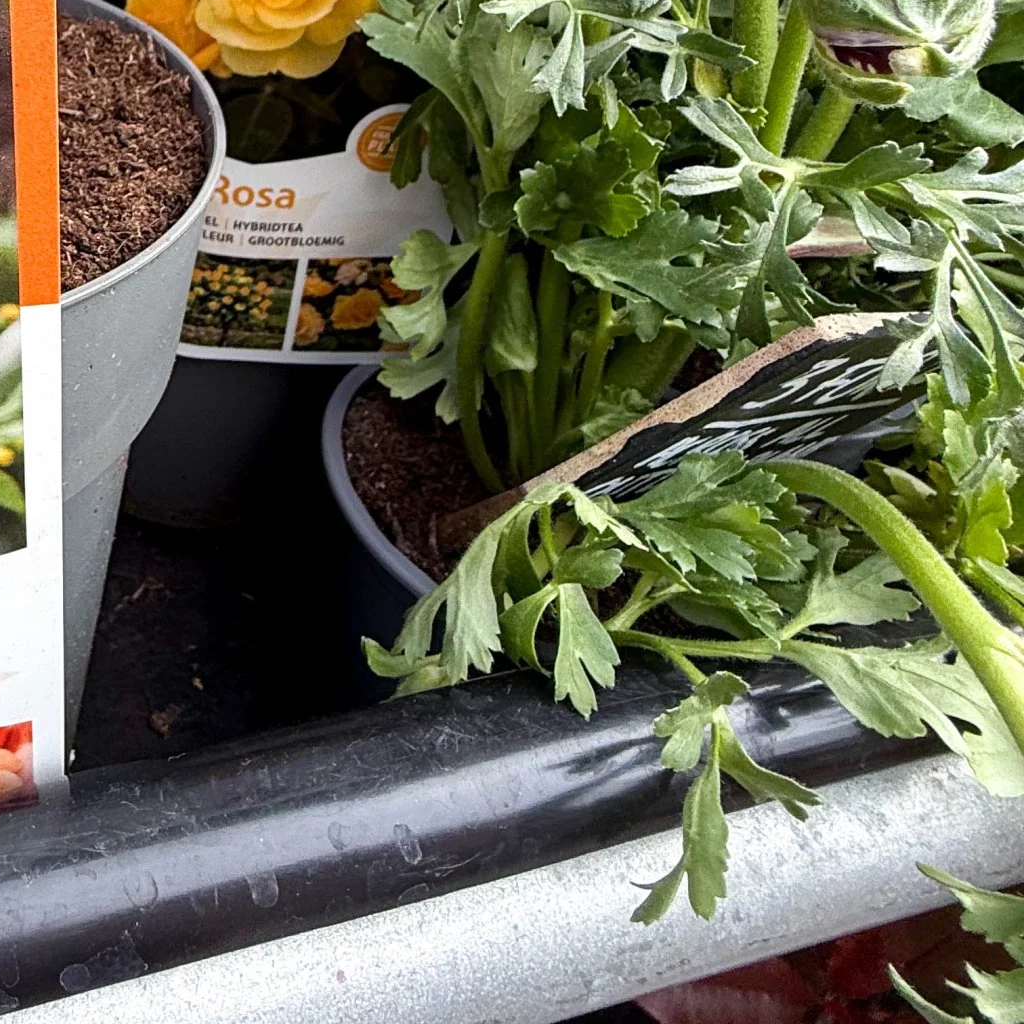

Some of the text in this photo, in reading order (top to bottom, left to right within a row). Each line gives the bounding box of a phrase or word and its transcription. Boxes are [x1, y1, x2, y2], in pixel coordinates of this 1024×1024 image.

[213, 175, 296, 210] Rosa
[233, 219, 304, 233] HYBRIDTEA
[247, 234, 345, 247] GROOTBLOEMIG
